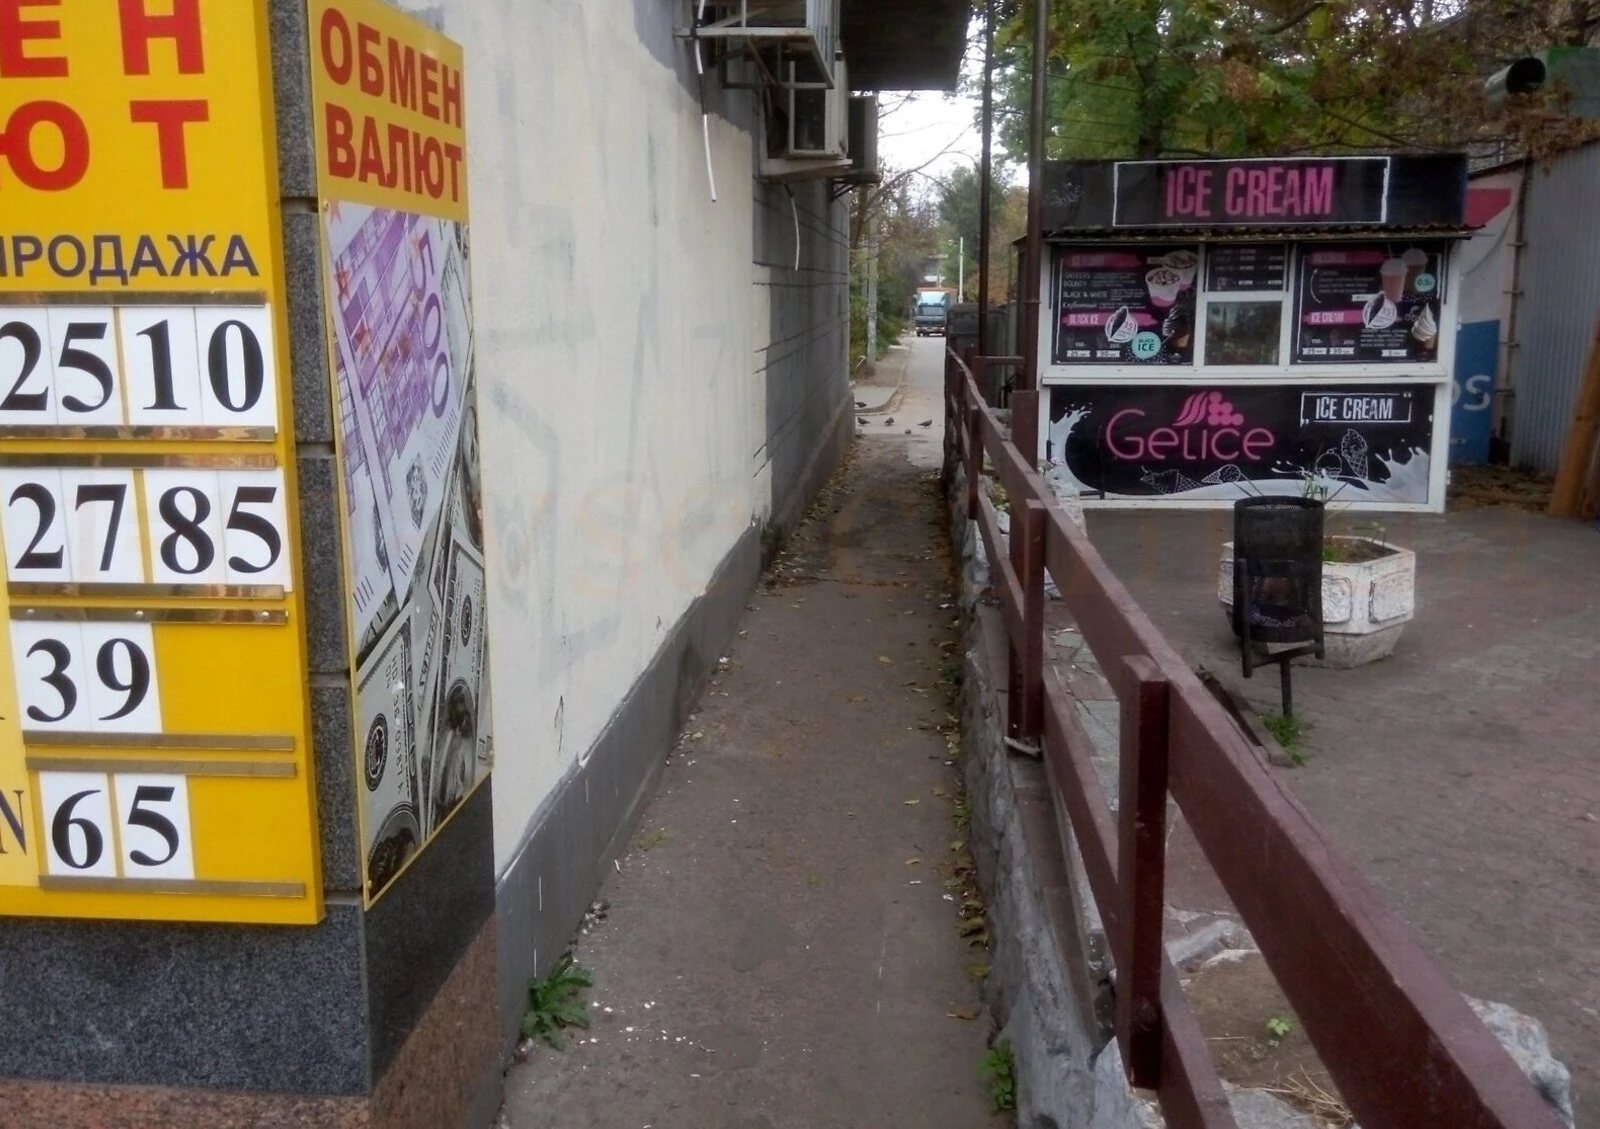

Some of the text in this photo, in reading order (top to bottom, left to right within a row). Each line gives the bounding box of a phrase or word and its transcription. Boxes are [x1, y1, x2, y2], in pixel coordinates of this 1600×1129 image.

[319, 8, 463, 129] ОБМЕН
[325, 102, 463, 203] ВАЛЮТ
[1165, 166, 1334, 218] ICE CREAM
[1311, 311, 1321, 323] ICE
[1138, 343, 1155, 351] ICE
[1315, 396, 1393, 420] ICE CREAM
[1452, 374, 1491, 411] S
[1106, 408, 1275, 460] Gelice
[26, 638, 150, 722] 39
[52, 785, 180, 869] 65
